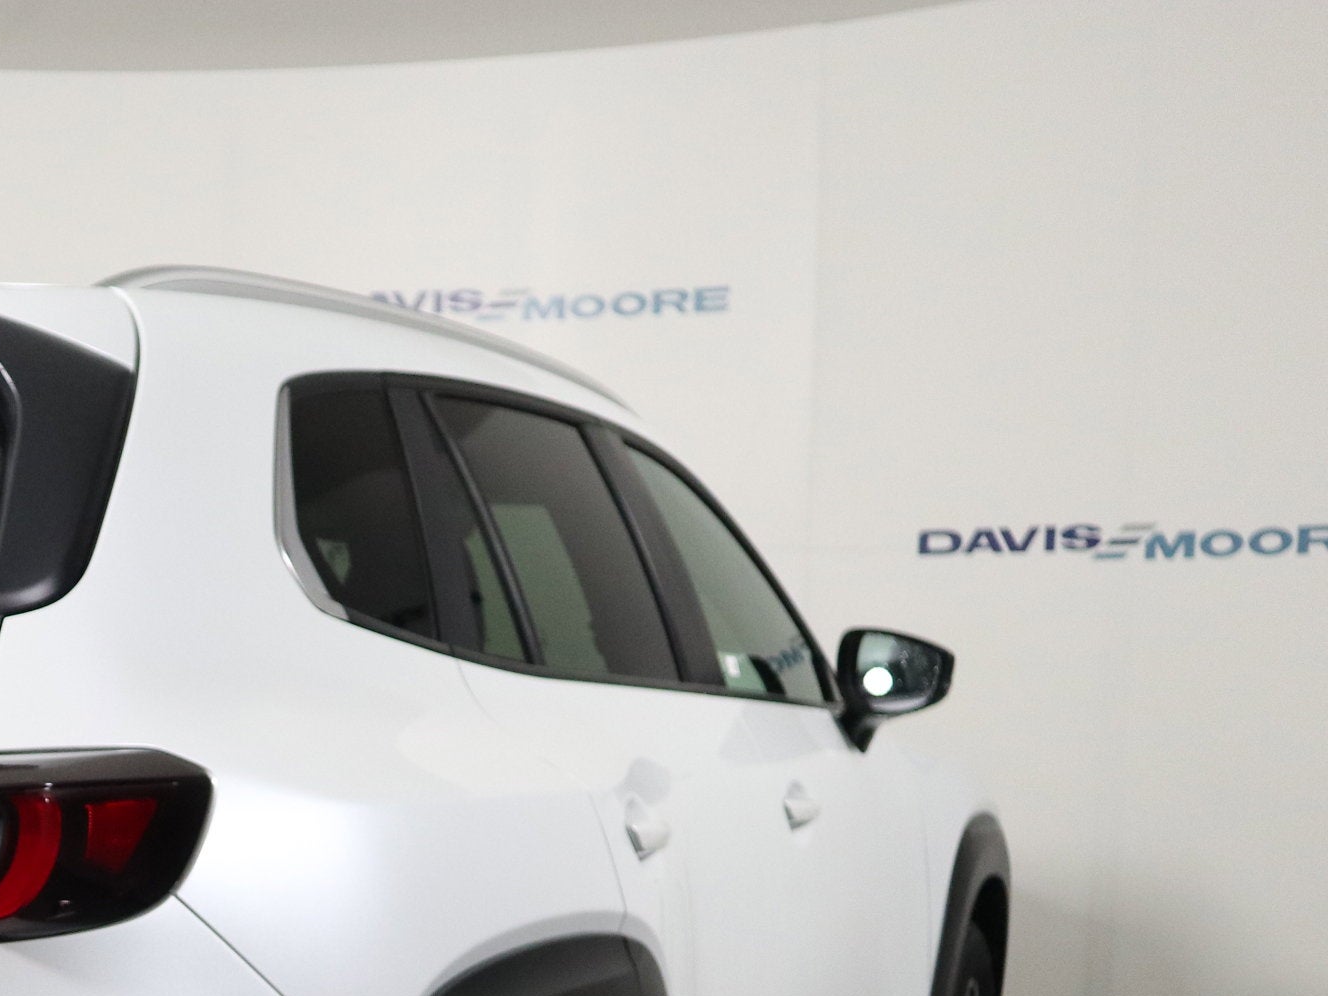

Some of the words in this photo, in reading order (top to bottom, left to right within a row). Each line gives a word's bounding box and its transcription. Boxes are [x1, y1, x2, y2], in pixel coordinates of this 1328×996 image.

[371, 287, 485, 314] AVIS
[521, 284, 730, 321] MOORE
[918, 523, 1102, 554] DAVIS
